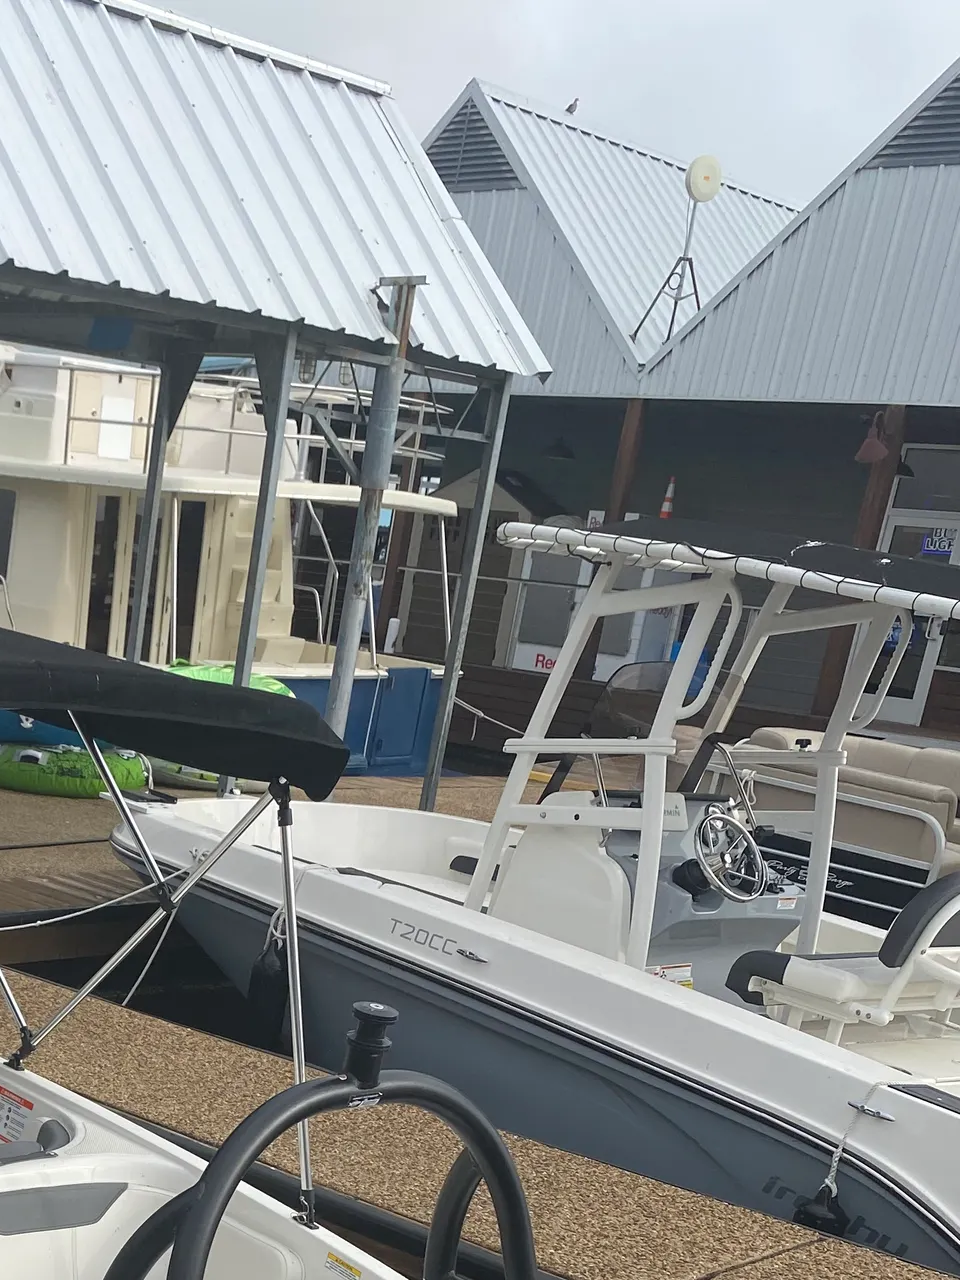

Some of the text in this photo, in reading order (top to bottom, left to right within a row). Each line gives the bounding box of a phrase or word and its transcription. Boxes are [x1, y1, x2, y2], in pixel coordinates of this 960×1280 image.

[925, 537, 954, 551] LIGH
[535, 653, 557, 669] Re
[390, 917, 458, 956] T20CC
